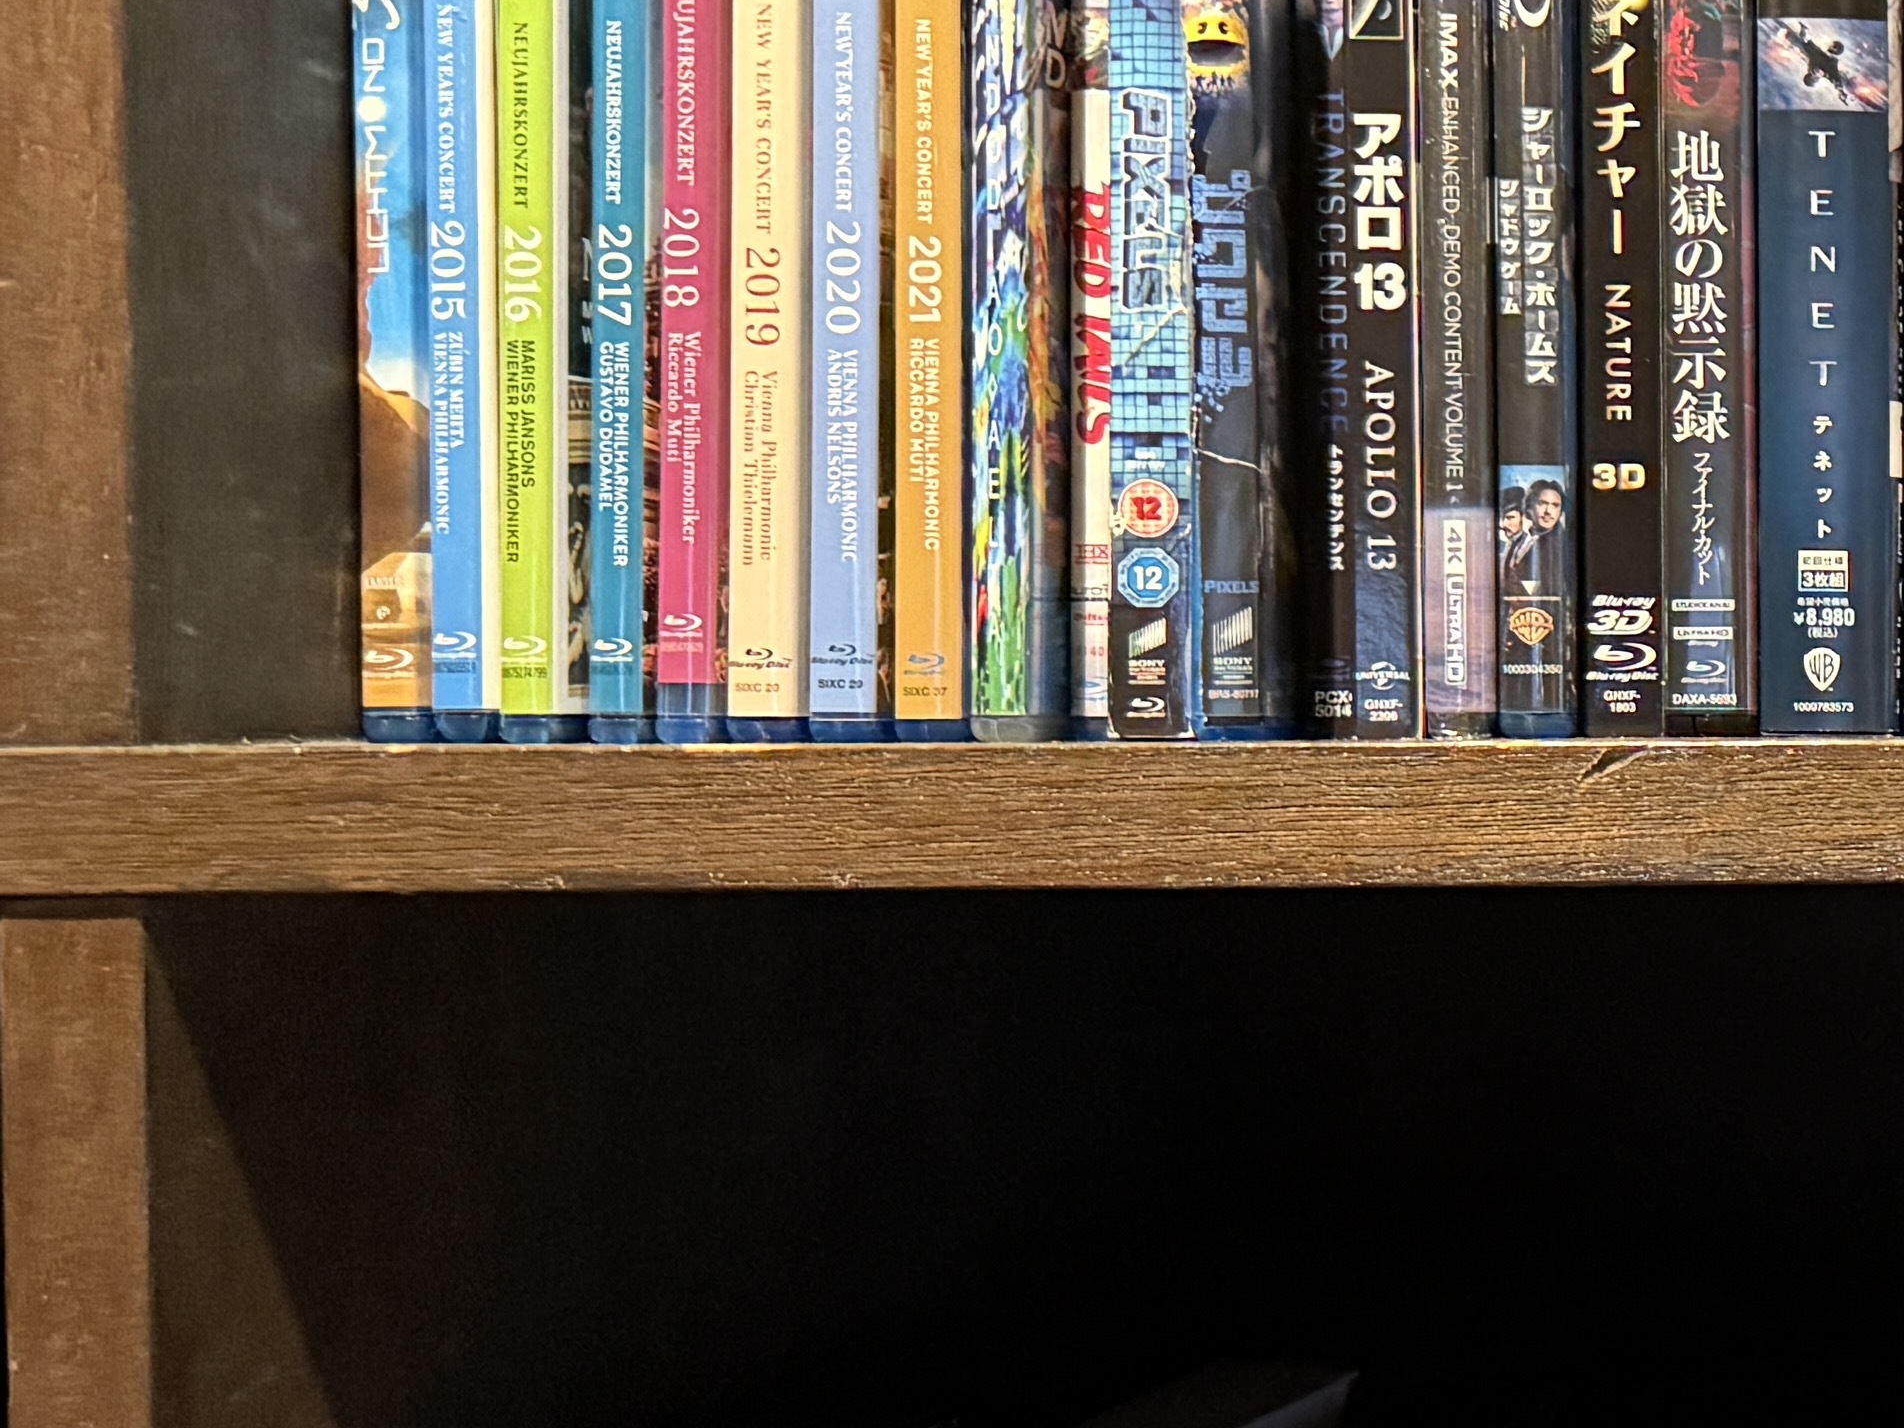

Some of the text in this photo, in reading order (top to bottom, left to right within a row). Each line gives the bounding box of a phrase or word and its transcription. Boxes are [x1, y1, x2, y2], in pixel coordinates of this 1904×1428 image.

[512, 21, 530, 209] NEUJAHRSKONZERT
[604, 19, 623, 204] NEUJAHRSKONZERT
[430, 220, 467, 321] 2015
[504, 224, 543, 323] 2016
[597, 223, 634, 326] 2017
[663, 208, 701, 309] 2018
[826, 220, 864, 335] 2020
[907, 235, 943, 323] 2021
[1316, 87, 1348, 433] TRANSCENDENCE
[1352, 112, 1409, 312] アポロ13
[1807, 130, 1837, 388] TENET
[745, 246, 782, 347] 2019
[1603, 283, 1632, 422] NATURE
[1669, 130, 1731, 446] 地獄の黙示録
[521, 339, 537, 489] MARISS JANSONS
[599, 341, 615, 512] GUSTAVO DUDAMEL
[615, 341, 631, 568] WIENER PHILHARMONIKER
[841, 349, 859, 563] VIENNA PHILHARMONIC
[907, 338, 925, 484] RICCARDO MUTI
[922, 338, 940, 552] VIENNA PHILHARMONIC
[1362, 360, 1397, 572] APOLLO 13
[1592, 462, 1647, 490] 3D
[1811, 415, 1835, 539] テネット
[1132, 497, 1164, 520] 12
[1132, 566, 1164, 590] 12
